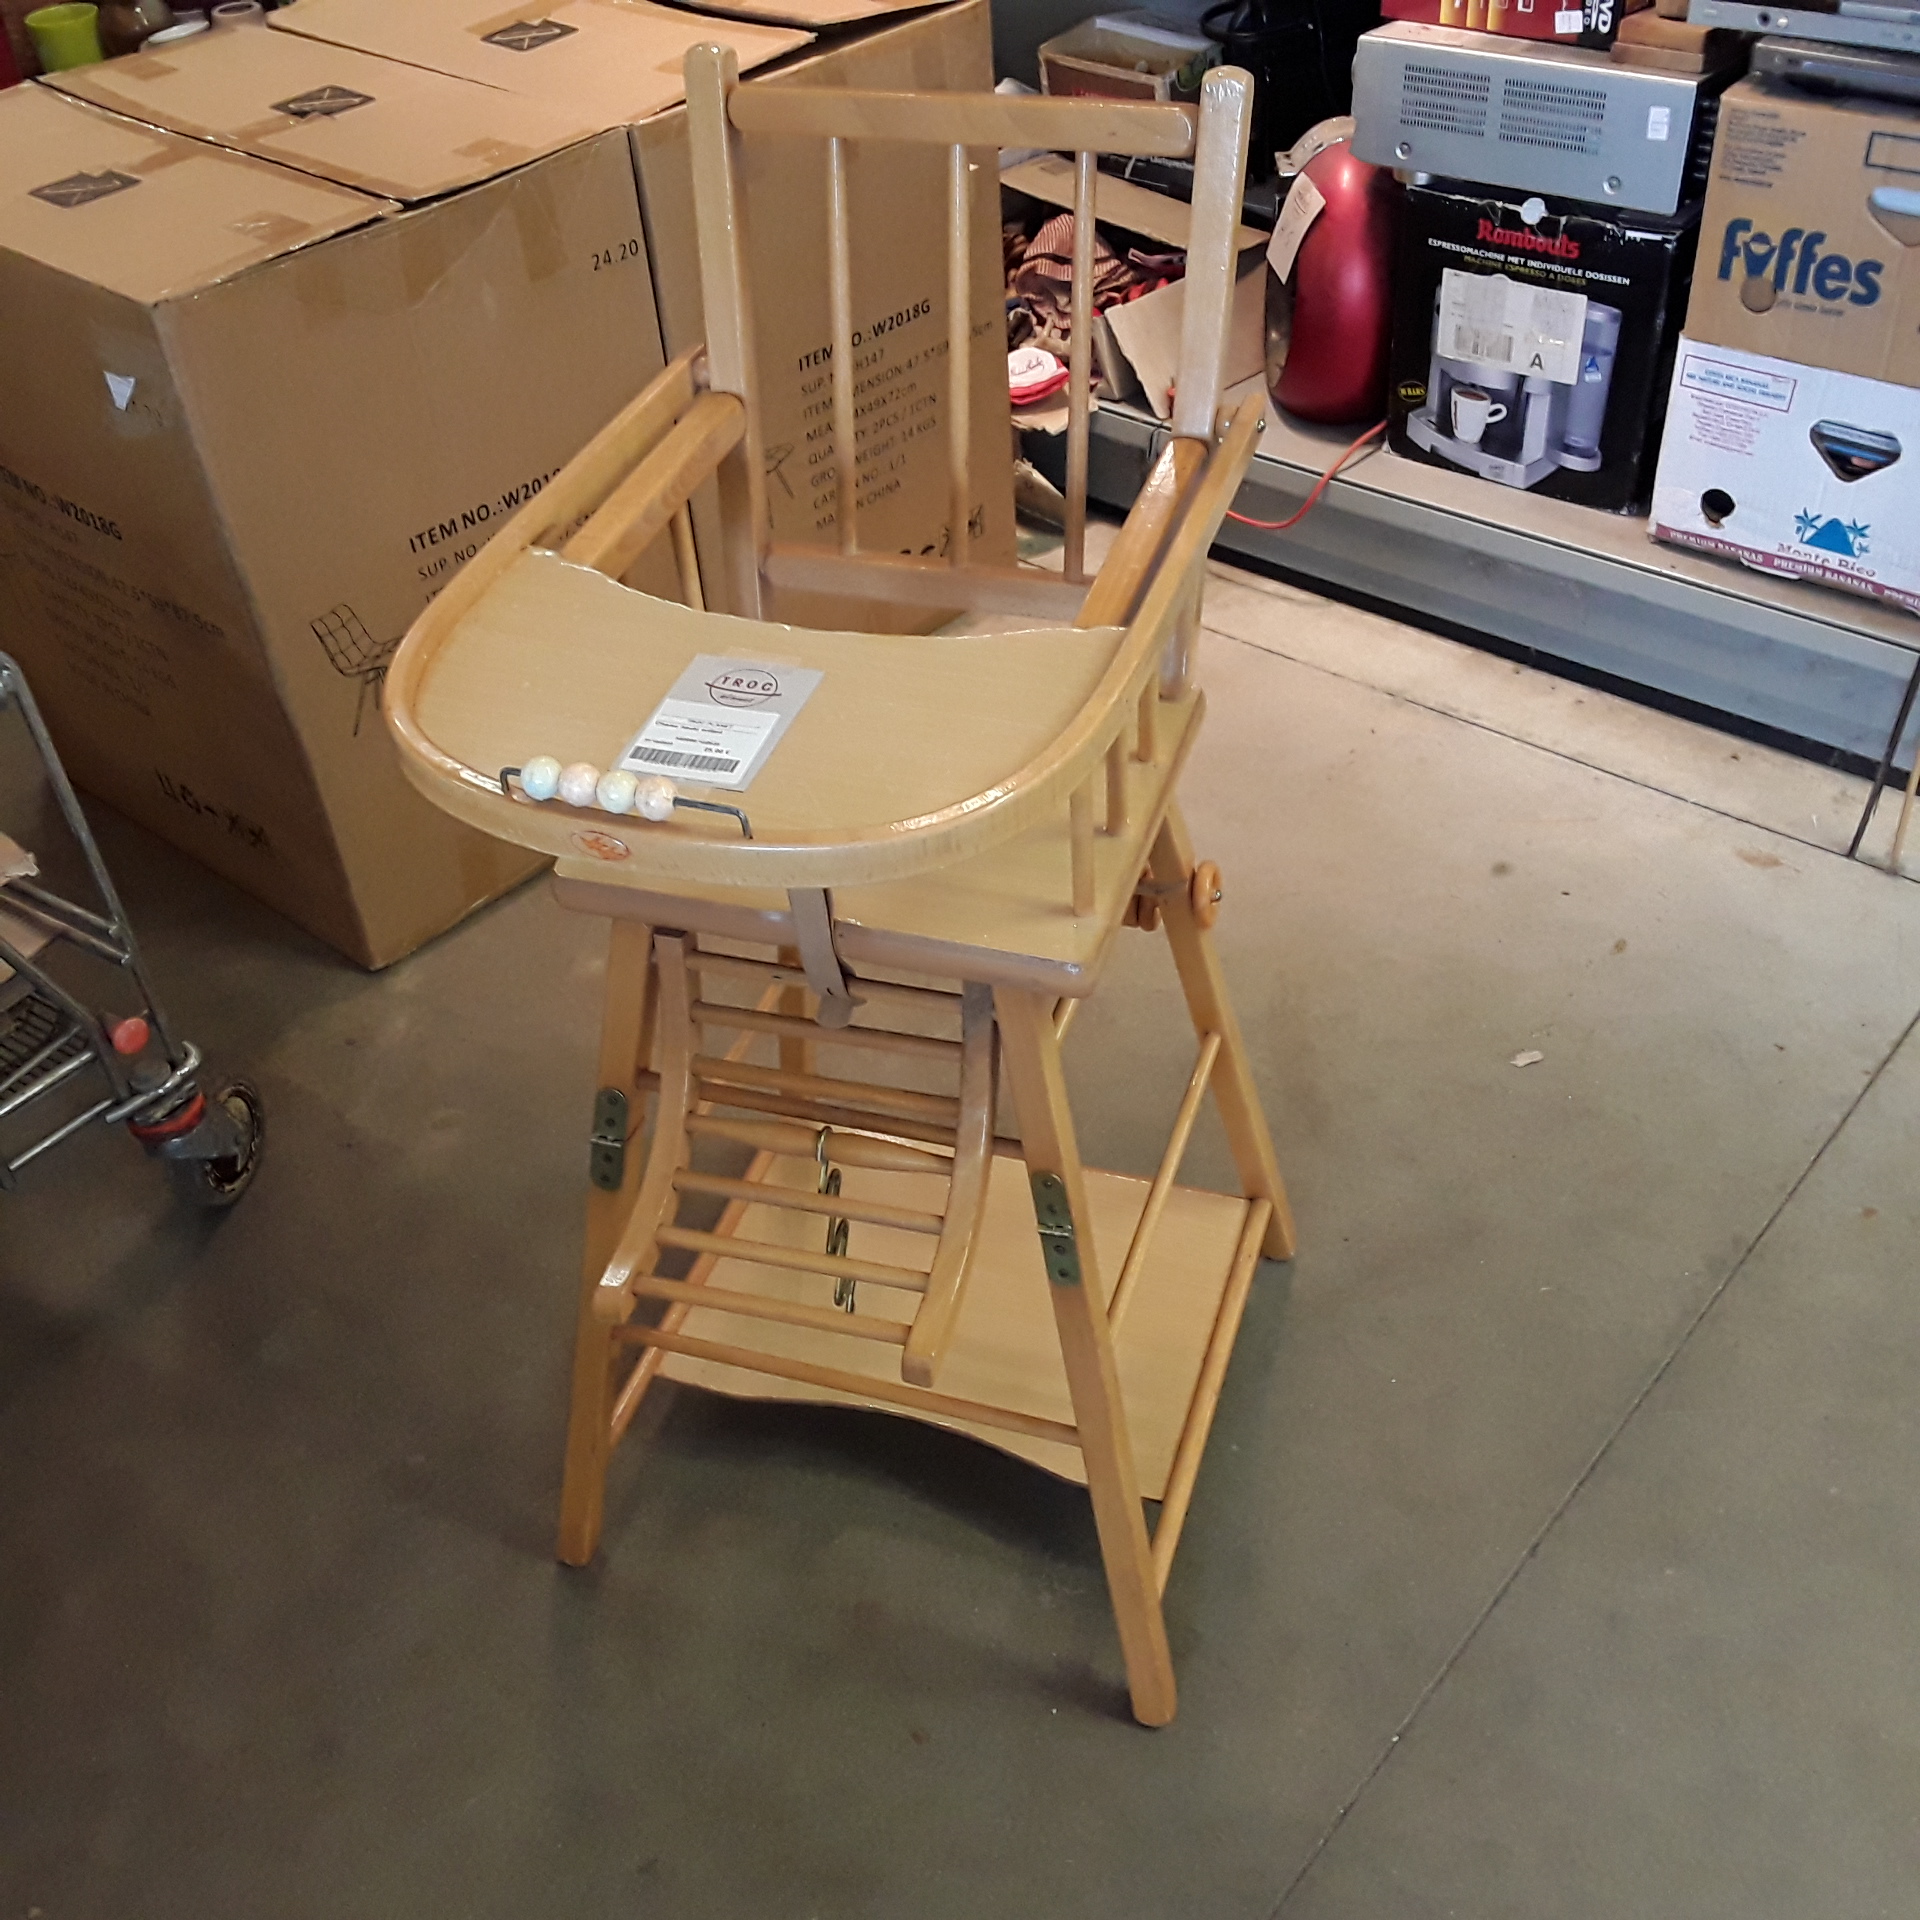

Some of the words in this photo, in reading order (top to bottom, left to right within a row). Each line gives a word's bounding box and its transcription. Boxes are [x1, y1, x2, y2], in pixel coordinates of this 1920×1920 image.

[591, 238, 639, 272] 24.20
[1506, 256, 1526, 267] MET
[1530, 352, 1545, 371] A
[408, 517, 459, 553] ITEM
[1837, 557, 1881, 578] Rico
[720, 675, 774, 692] TROC
